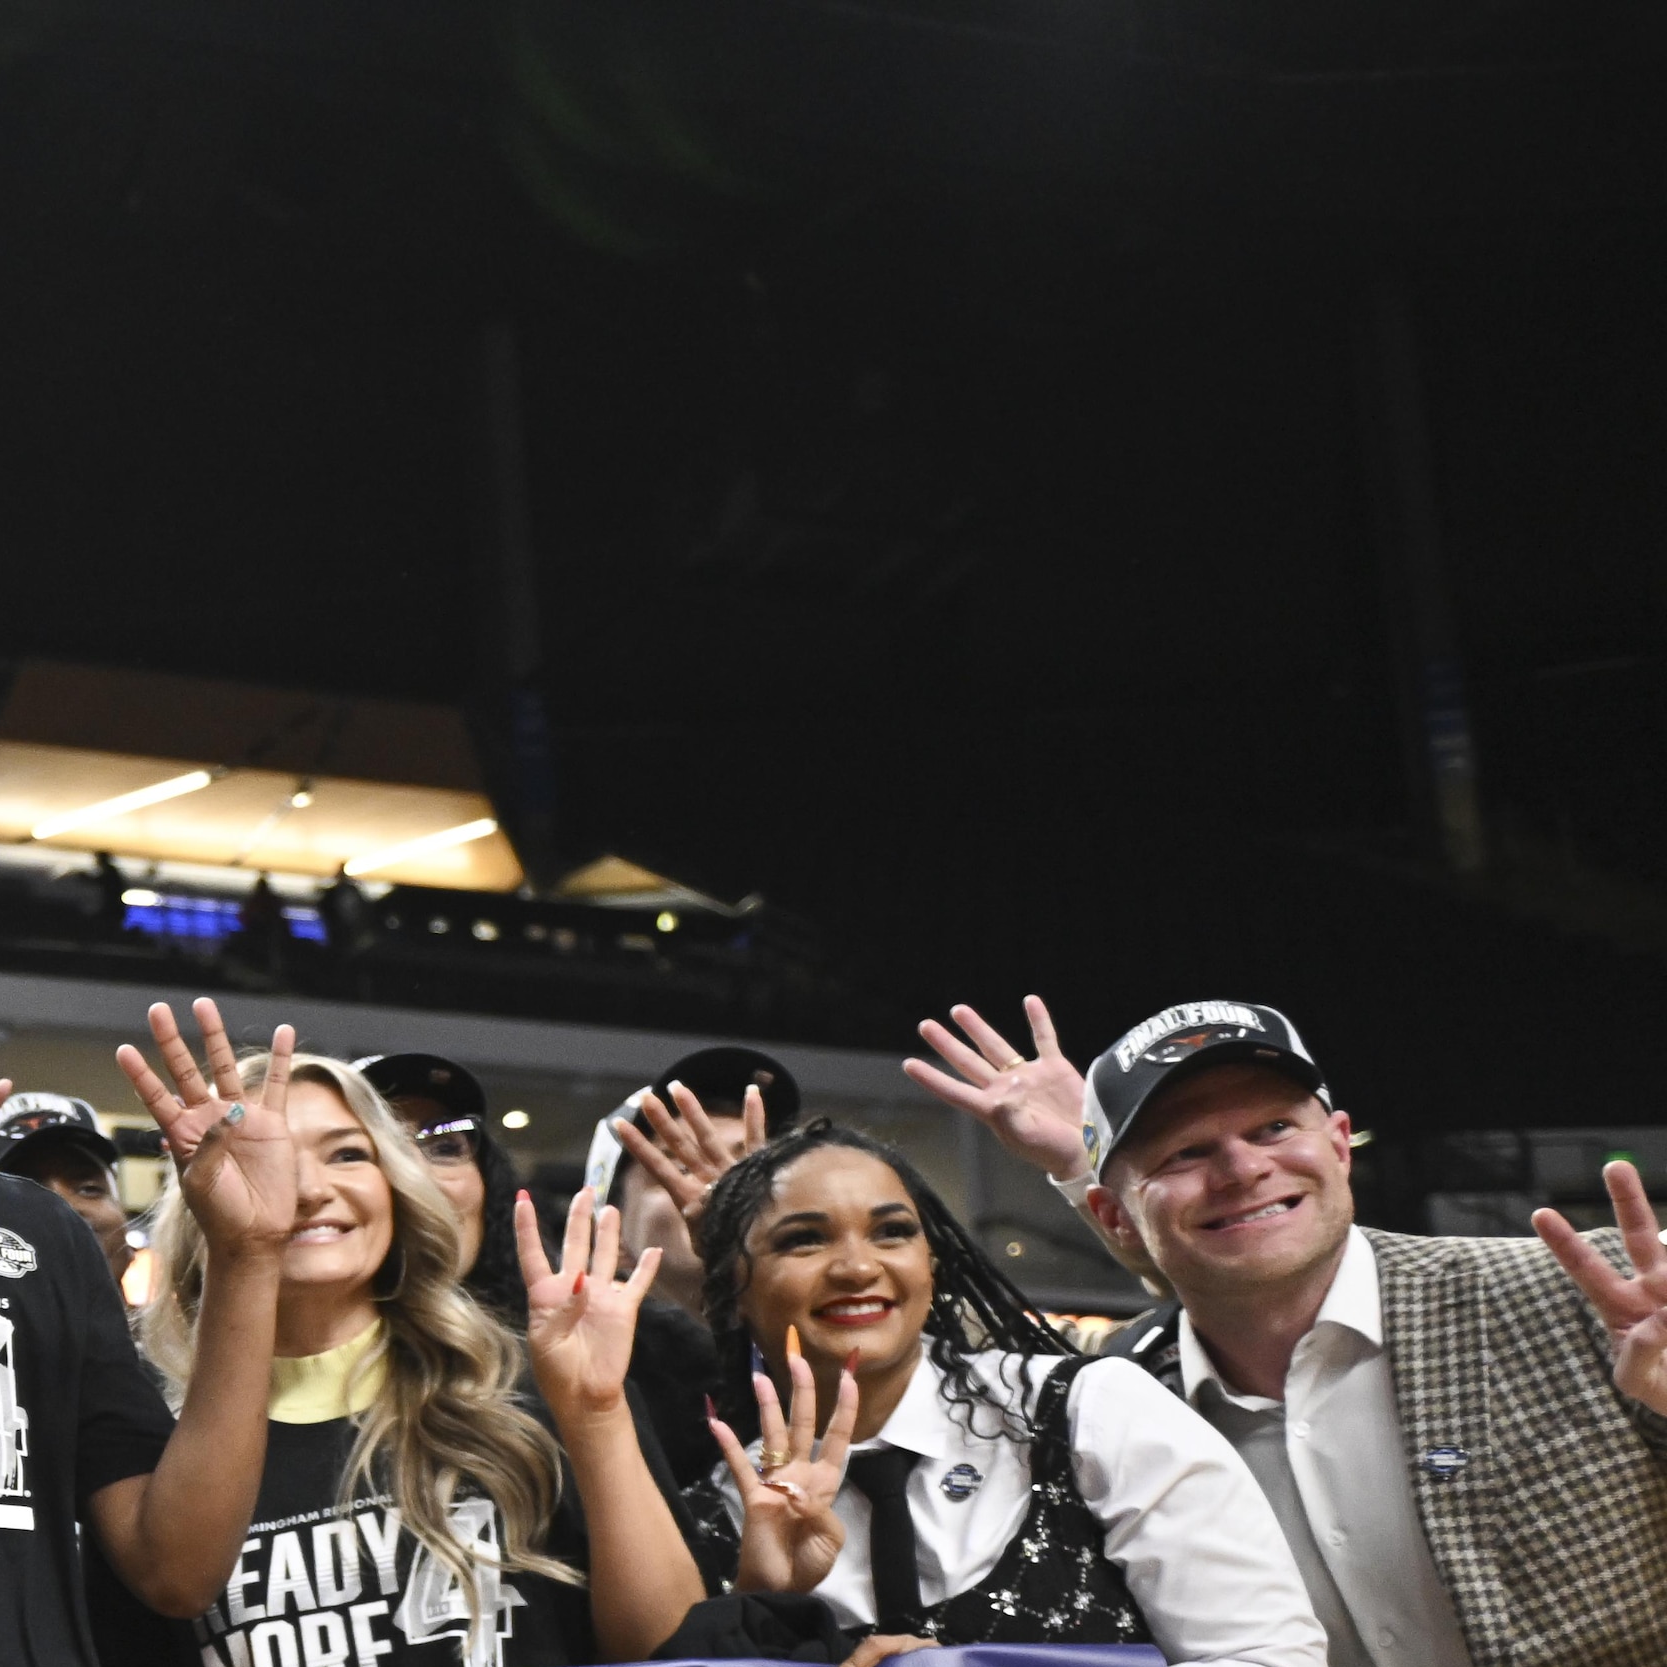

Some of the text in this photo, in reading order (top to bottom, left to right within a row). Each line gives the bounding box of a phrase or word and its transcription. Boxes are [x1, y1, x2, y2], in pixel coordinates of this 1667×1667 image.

[1117, 1002, 1265, 1072] FINAL FOUR
[248, 1510, 320, 1534] MINGHAM
